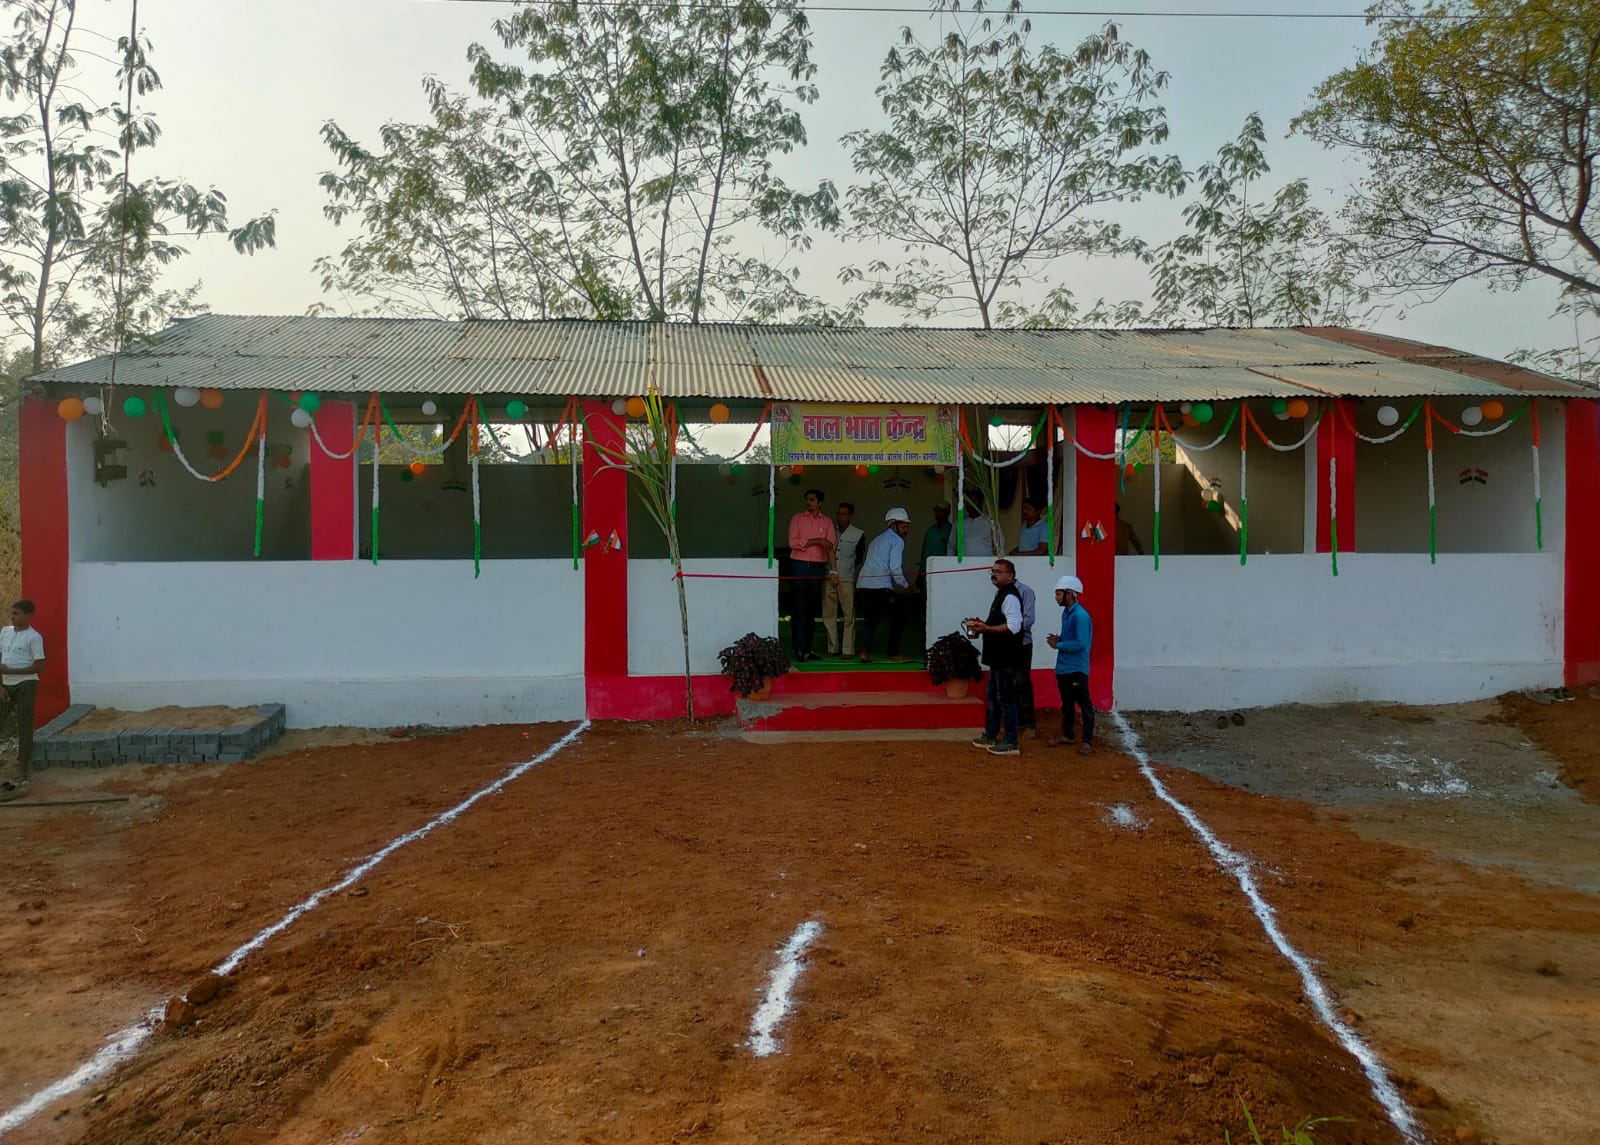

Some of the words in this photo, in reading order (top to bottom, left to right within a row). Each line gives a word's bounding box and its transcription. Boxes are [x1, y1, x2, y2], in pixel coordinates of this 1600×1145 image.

[802, 415, 842, 441] दाल
[844, 415, 882, 441] भात
[885, 408, 927, 441] केन्द्र
